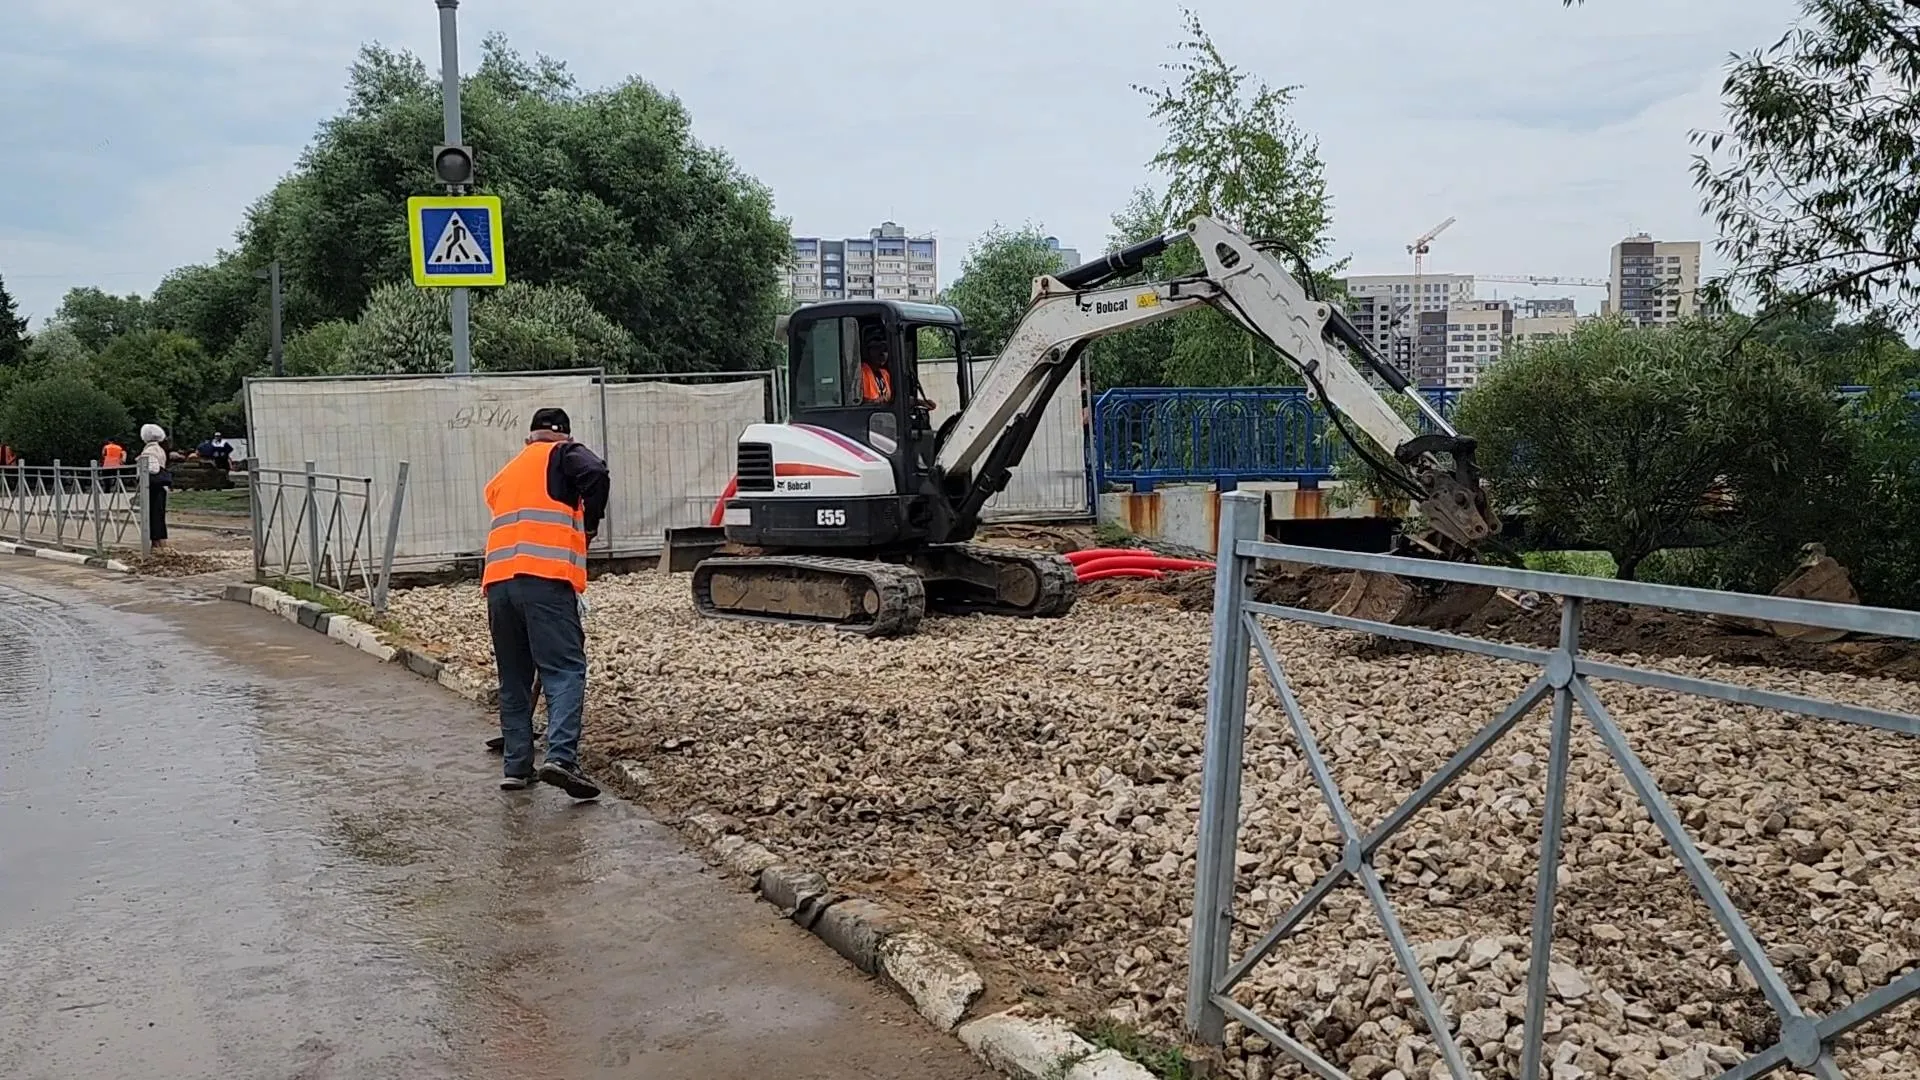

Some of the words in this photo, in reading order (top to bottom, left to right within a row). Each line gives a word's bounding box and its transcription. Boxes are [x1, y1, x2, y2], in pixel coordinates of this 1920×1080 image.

[1096, 299, 1128, 314] Bobcat
[787, 481, 811, 491] Bobcat
[817, 509, 846, 526] E55
